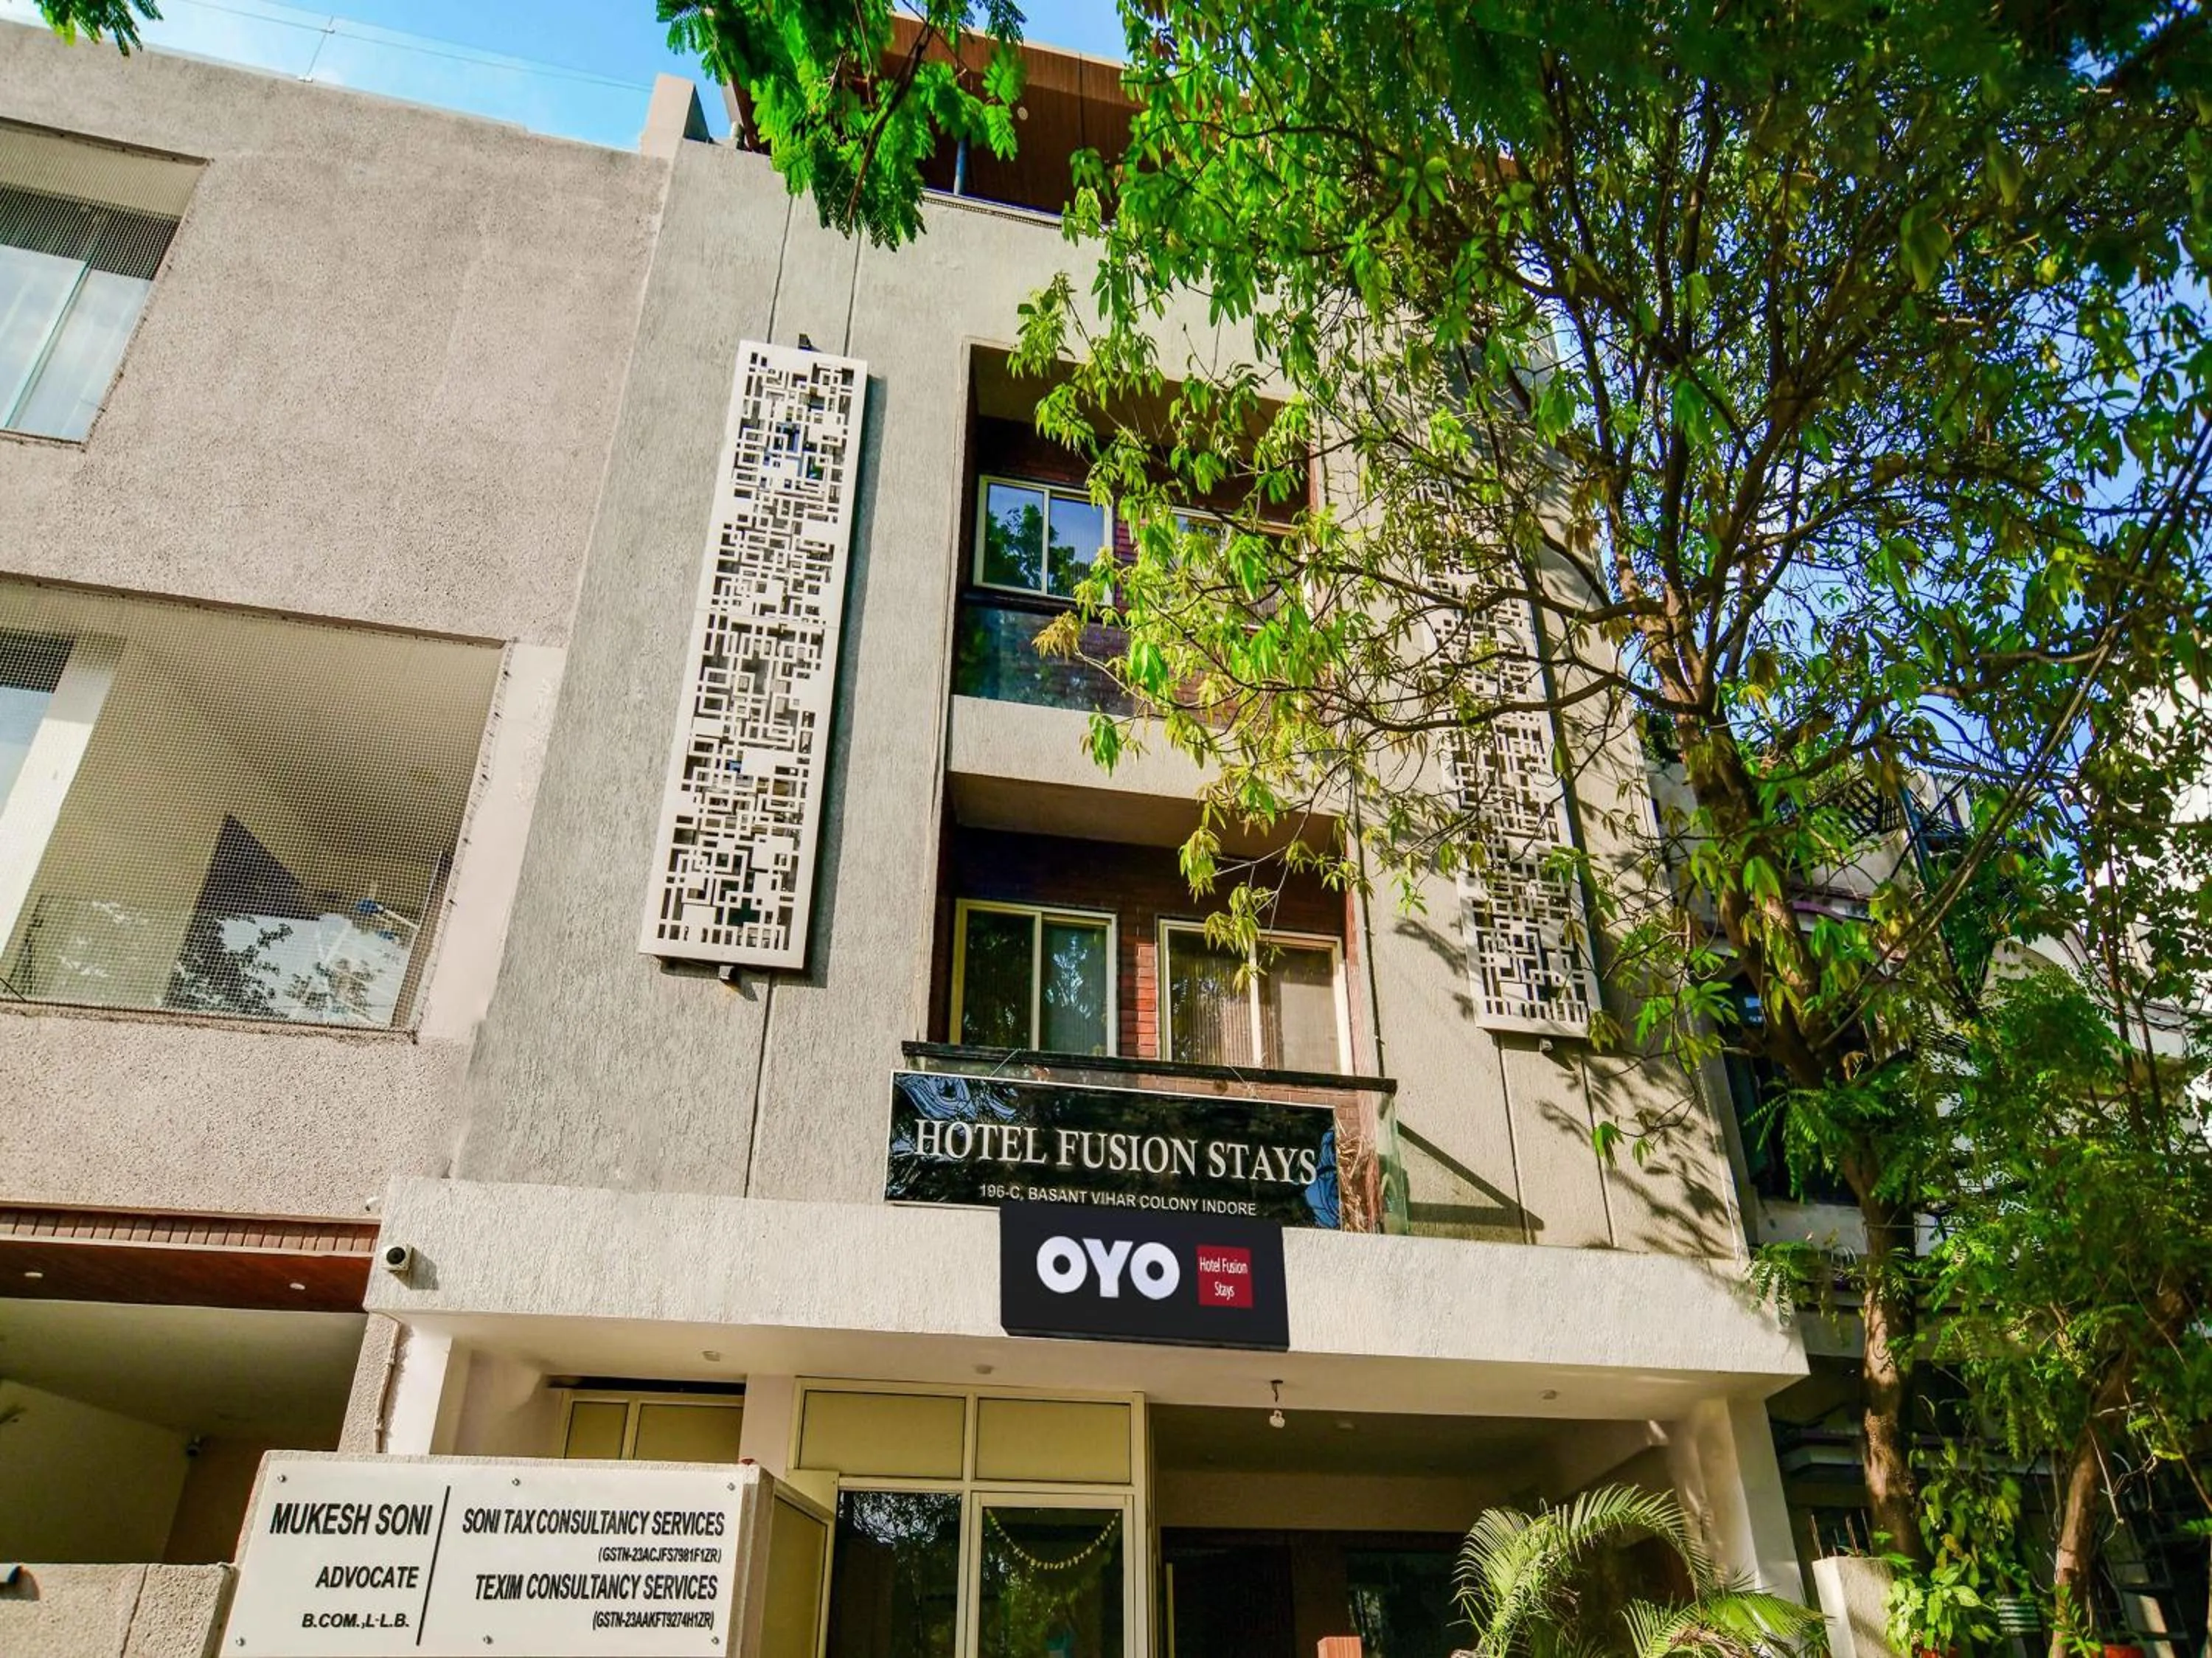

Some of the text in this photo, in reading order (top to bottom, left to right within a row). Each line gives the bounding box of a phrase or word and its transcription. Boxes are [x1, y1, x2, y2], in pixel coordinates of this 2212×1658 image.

[915, 1118, 1318, 1185] HOTEL FUSION STAYS
[979, 1184, 1256, 1216] 196-C, BASANT VIHAR COLONY INDORE
[1036, 1235, 1180, 1300] OYO
[1198, 1255, 1248, 1274] Hotel Fusion
[1214, 1281, 1235, 1300] Stays
[269, 1503, 433, 1536] MUKESH SONI
[462, 1510, 725, 1536] SONI TAX CONSULTANCY SERVICES
[316, 1566, 420, 1589] ADVOCATE
[476, 1573, 718, 1600] TEXIM CONSULTANCY SERVICES
